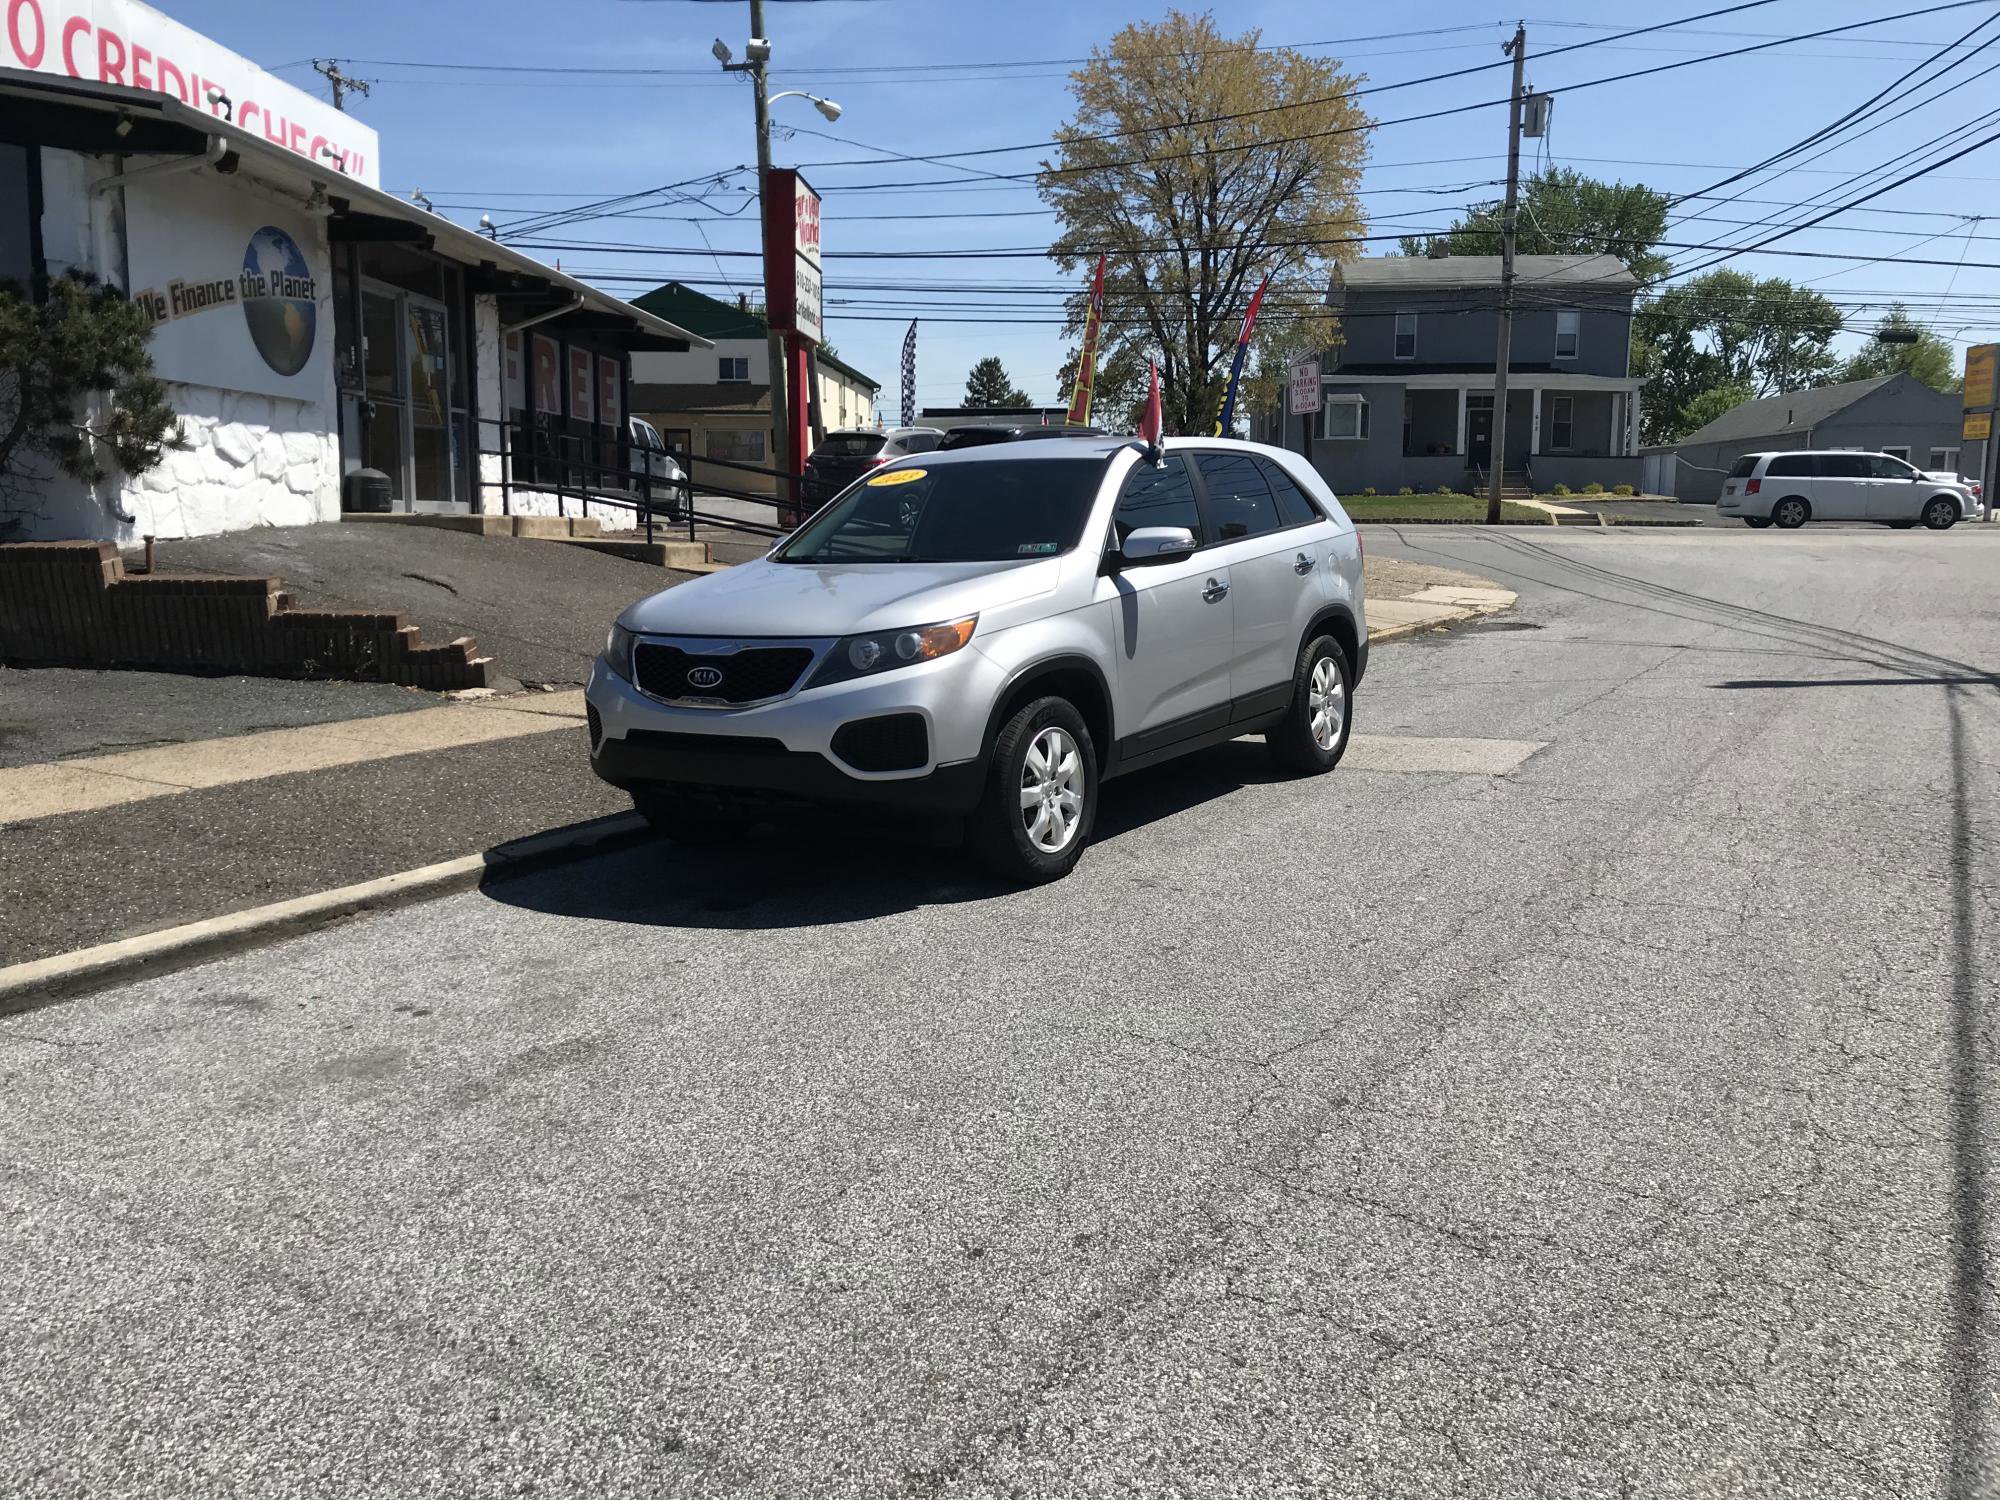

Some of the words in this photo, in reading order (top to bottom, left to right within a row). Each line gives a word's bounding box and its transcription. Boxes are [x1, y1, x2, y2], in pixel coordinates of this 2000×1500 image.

[133, 292, 167, 321] We
[169, 279, 235, 315] Finance
[239, 273, 266, 299] the
[270, 269, 317, 300] Planet
[1299, 366, 1309, 378] NO
[1292, 376, 1317, 389] PARKING
[694, 671, 716, 683] KIA
